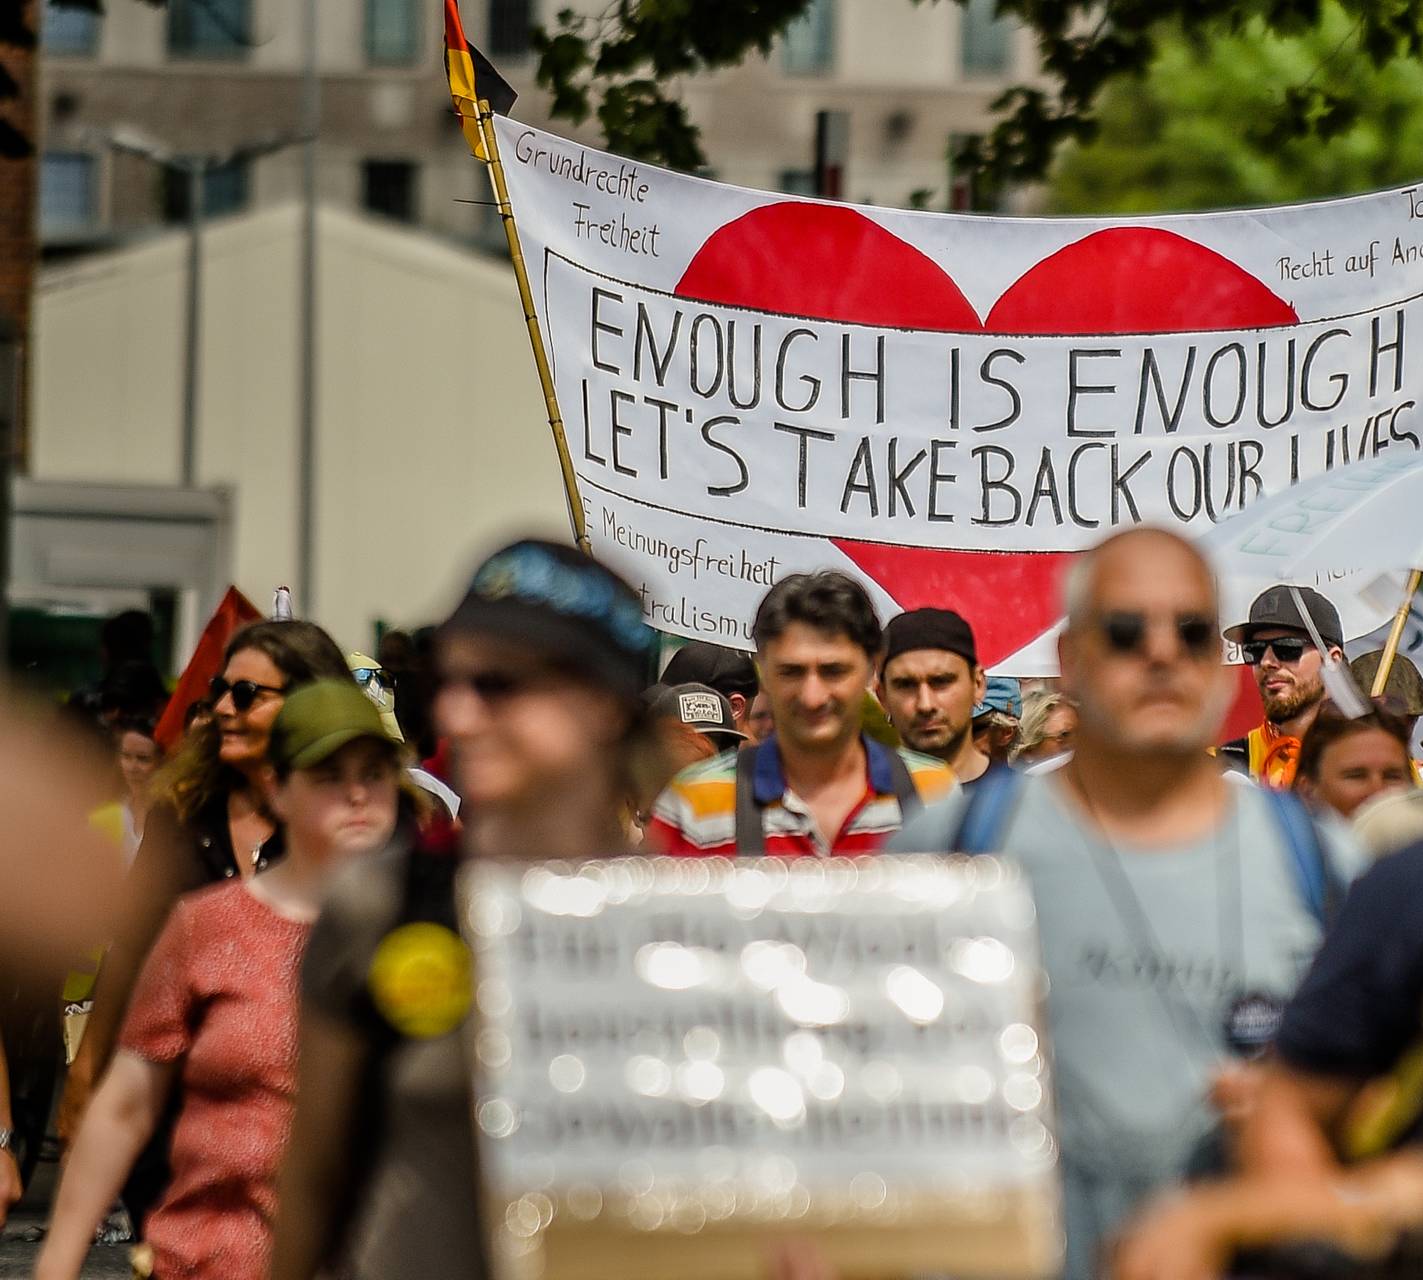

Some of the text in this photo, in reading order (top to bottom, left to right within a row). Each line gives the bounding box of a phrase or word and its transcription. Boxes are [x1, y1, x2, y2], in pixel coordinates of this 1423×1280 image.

[515, 130, 649, 203] Grundrechte
[573, 202, 660, 257] Freiheit
[1276, 249, 1334, 281] Recht
[1345, 240, 1380, 278] auf
[592, 285, 1404, 438] ENOUGH IS ENOUGH
[582, 378, 749, 497] LET'S
[774, 422, 958, 523] TAKE
[971, 442, 1152, 529] BACK
[1166, 440, 1264, 525] OUR
[602, 505, 781, 587] Meinungsfreiheit
